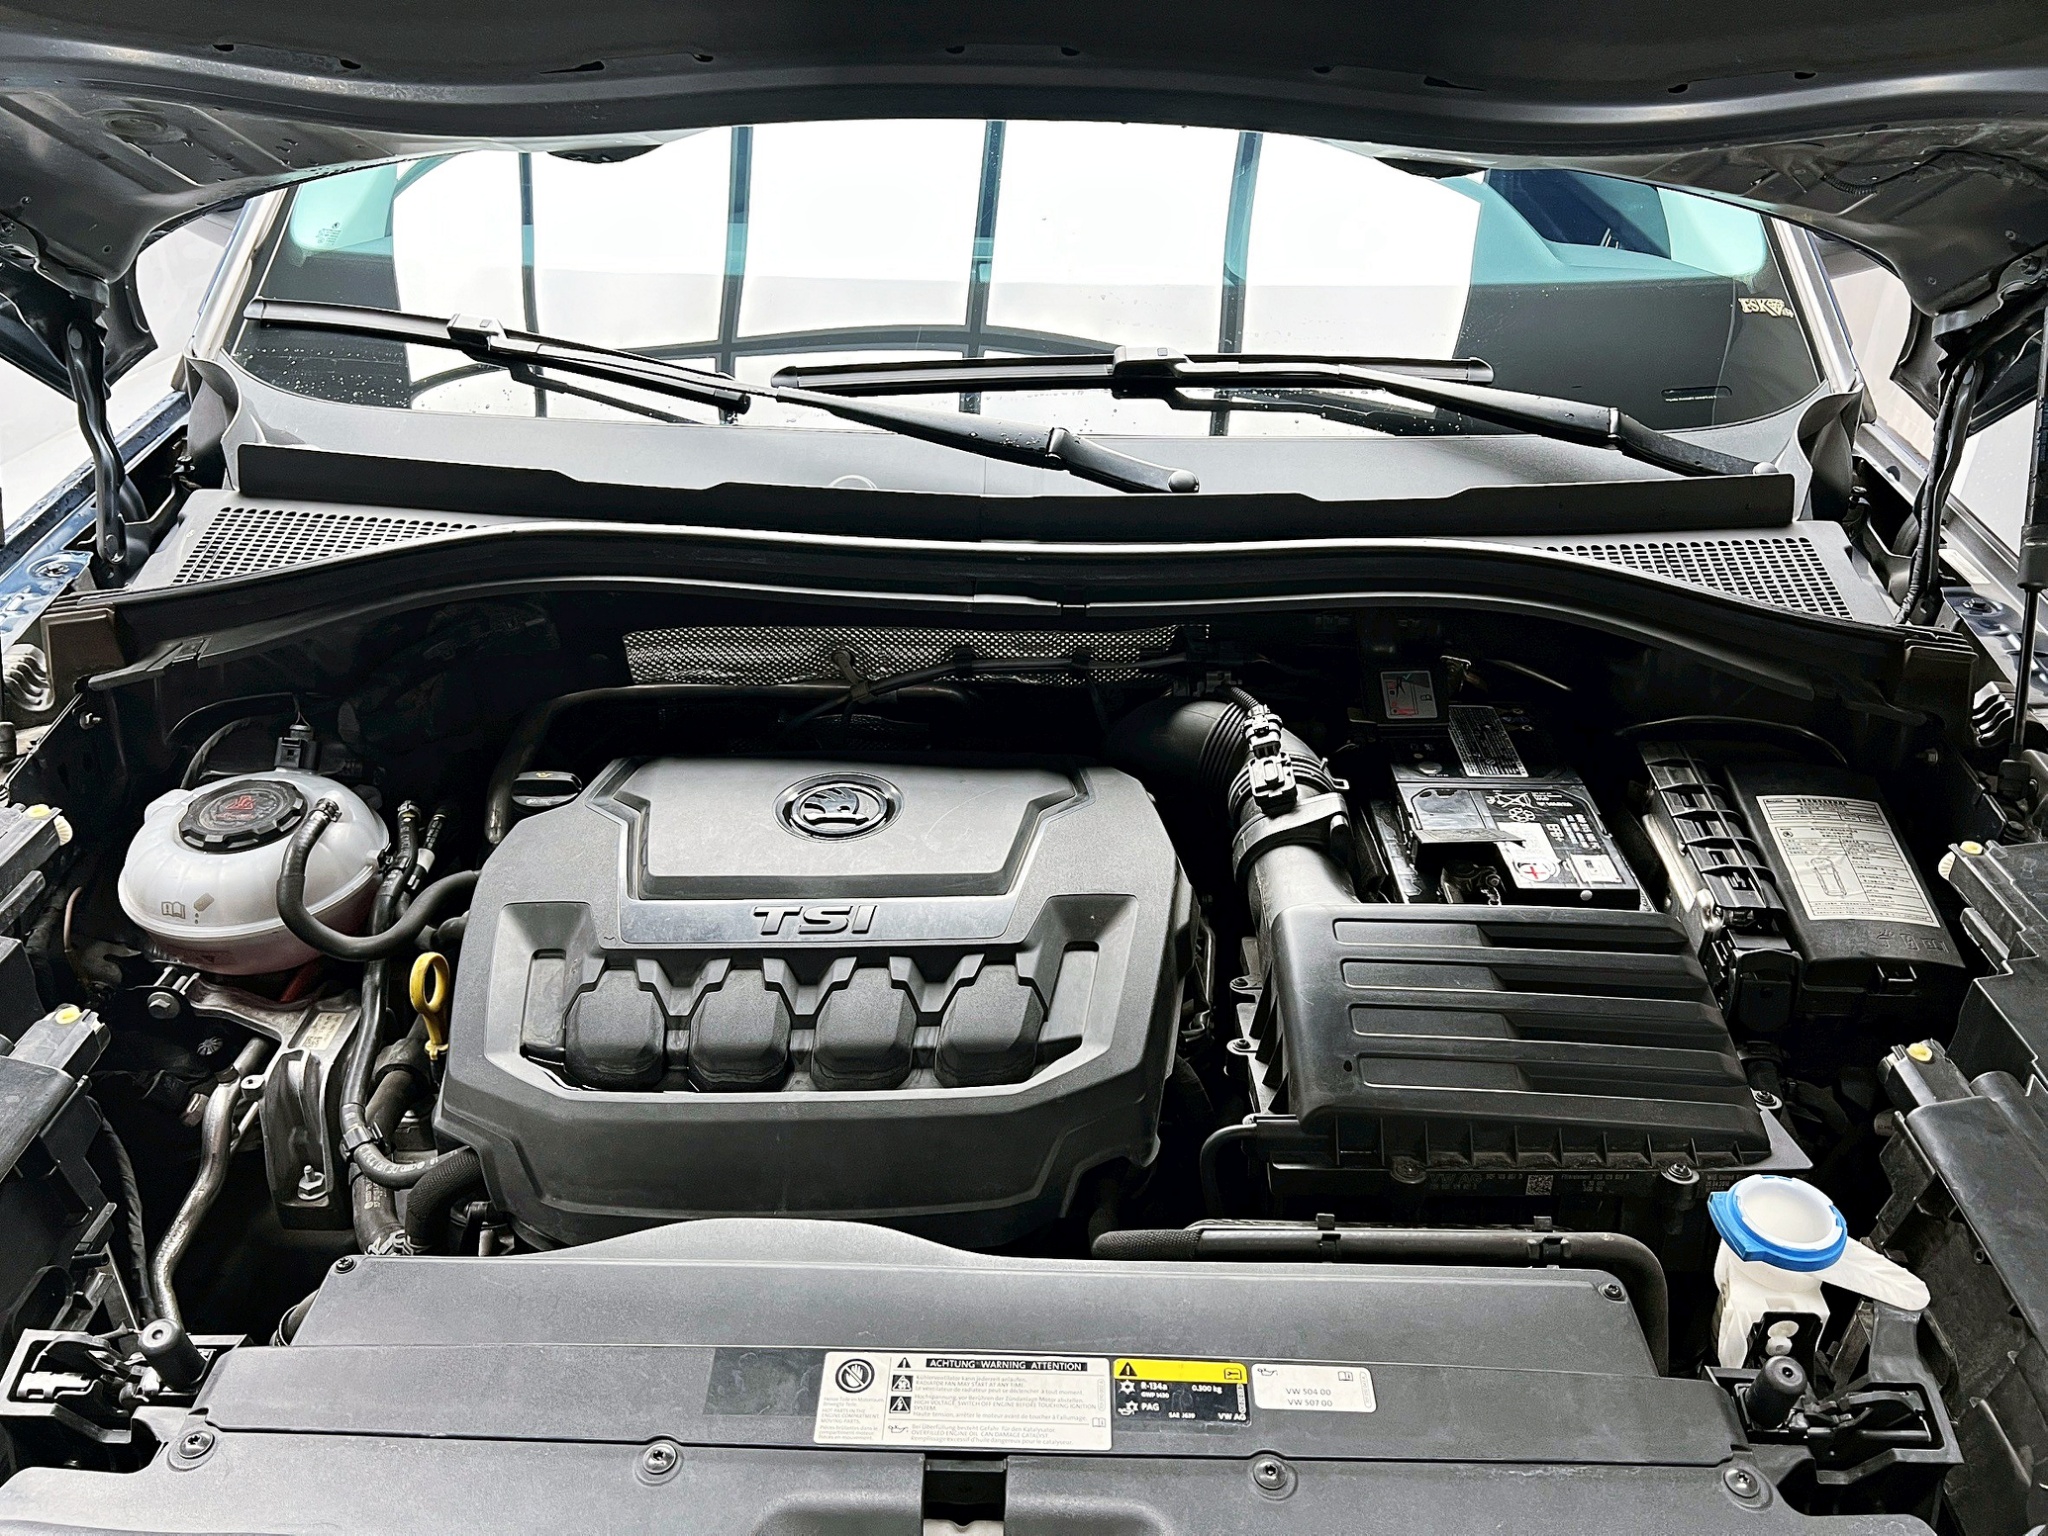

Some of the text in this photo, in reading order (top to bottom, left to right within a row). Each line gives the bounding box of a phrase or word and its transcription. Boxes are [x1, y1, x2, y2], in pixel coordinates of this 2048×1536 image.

[753, 904, 878, 936] TSI
[930, 1360, 1082, 1370] ACHTUNG WARNING ATTENTION
[1140, 1382, 1168, 1391] R-134a
[1140, 1403, 1160, 1411] PAG
